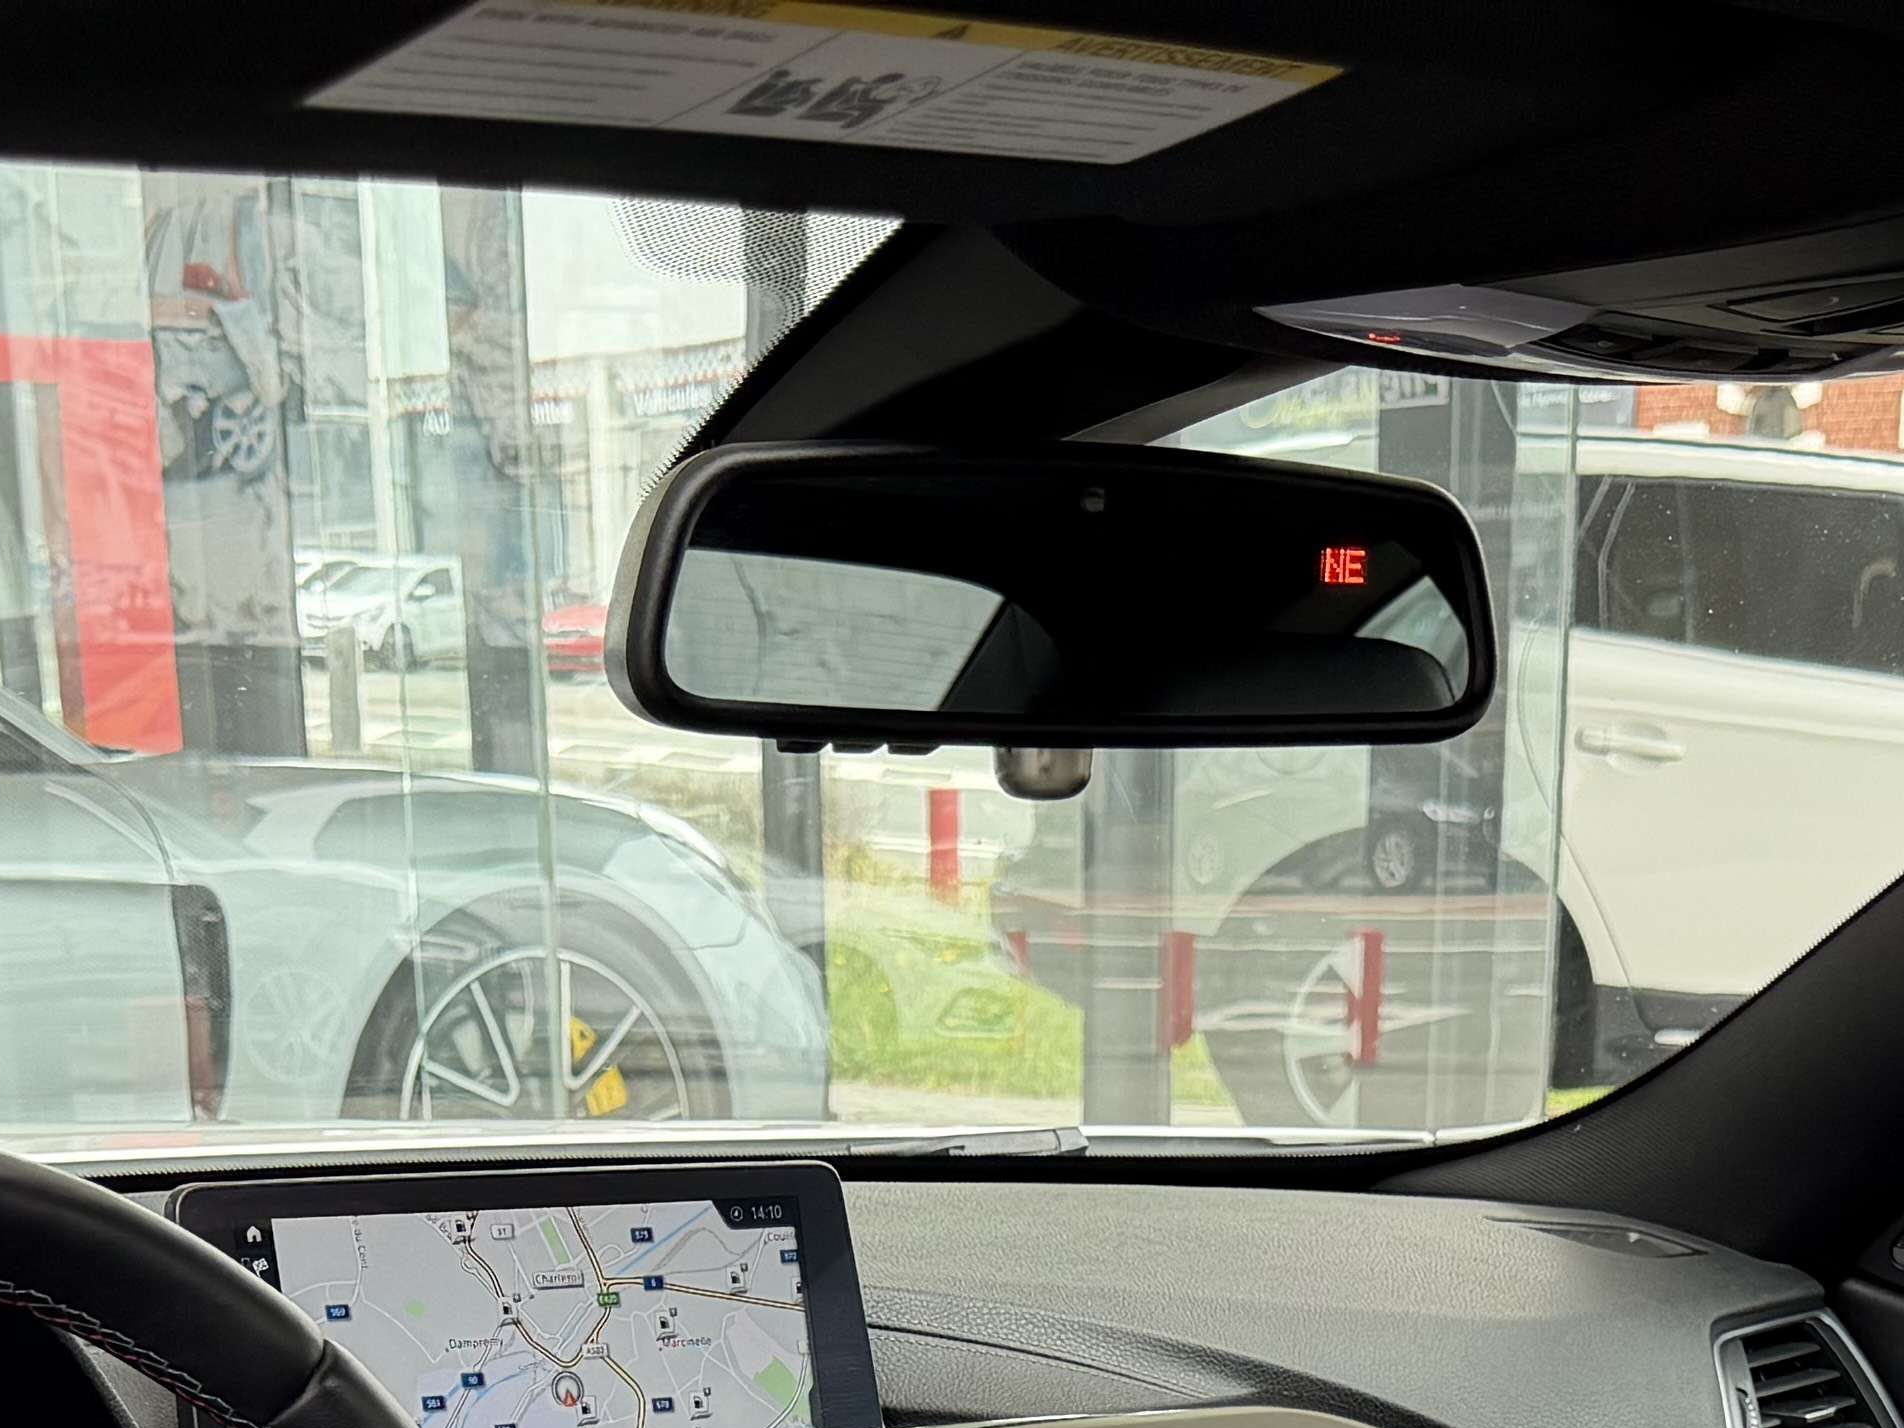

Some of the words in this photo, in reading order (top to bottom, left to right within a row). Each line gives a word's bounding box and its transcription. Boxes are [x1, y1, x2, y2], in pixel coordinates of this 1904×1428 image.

[1053, 36, 1305, 79] AVERTISSEMENT
[1321, 547, 1366, 583] NE
[751, 1205, 783, 1220] 14:10
